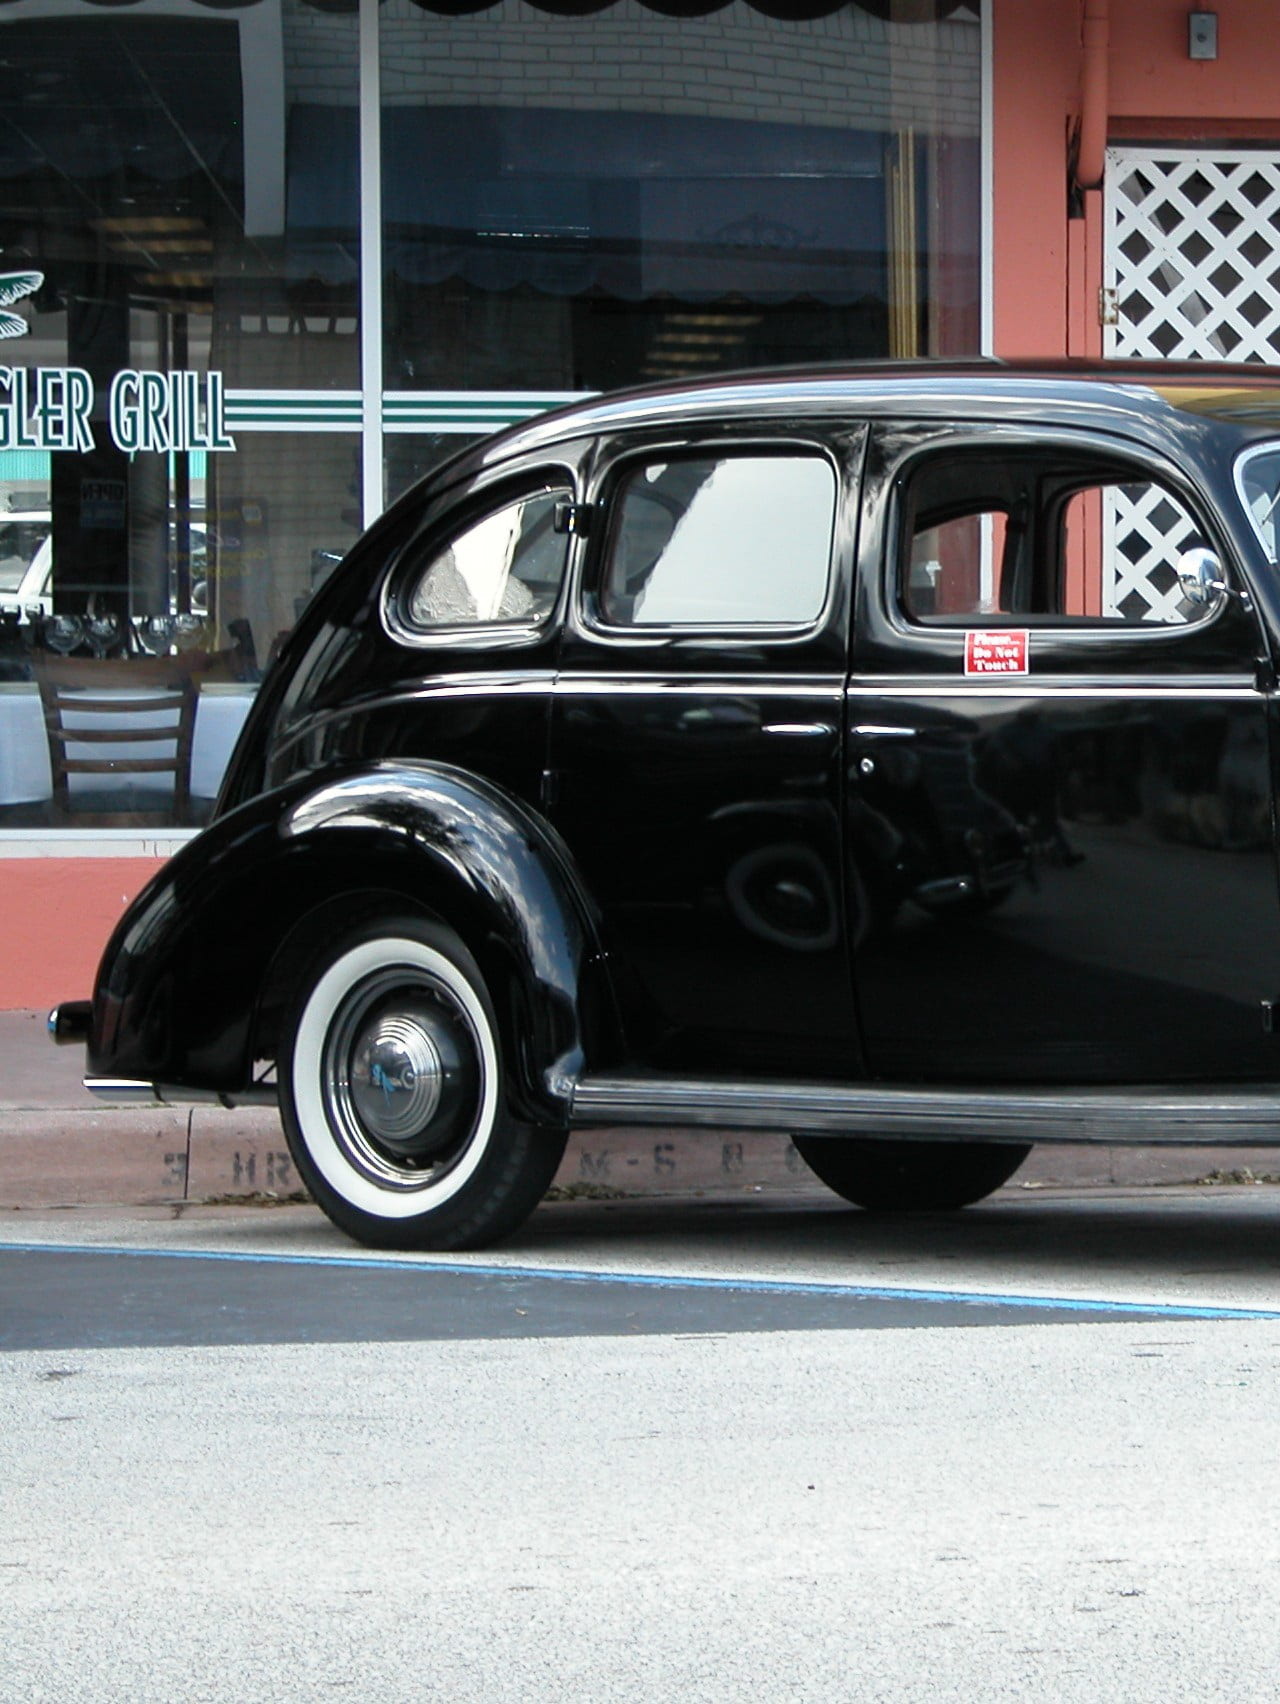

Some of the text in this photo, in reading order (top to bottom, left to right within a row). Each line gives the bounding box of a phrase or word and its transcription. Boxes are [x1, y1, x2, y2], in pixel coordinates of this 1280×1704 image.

[111, 369, 236, 454] GRILL
[973, 646, 1018, 658] Do Not
[973, 659, 1018, 671] Touch
